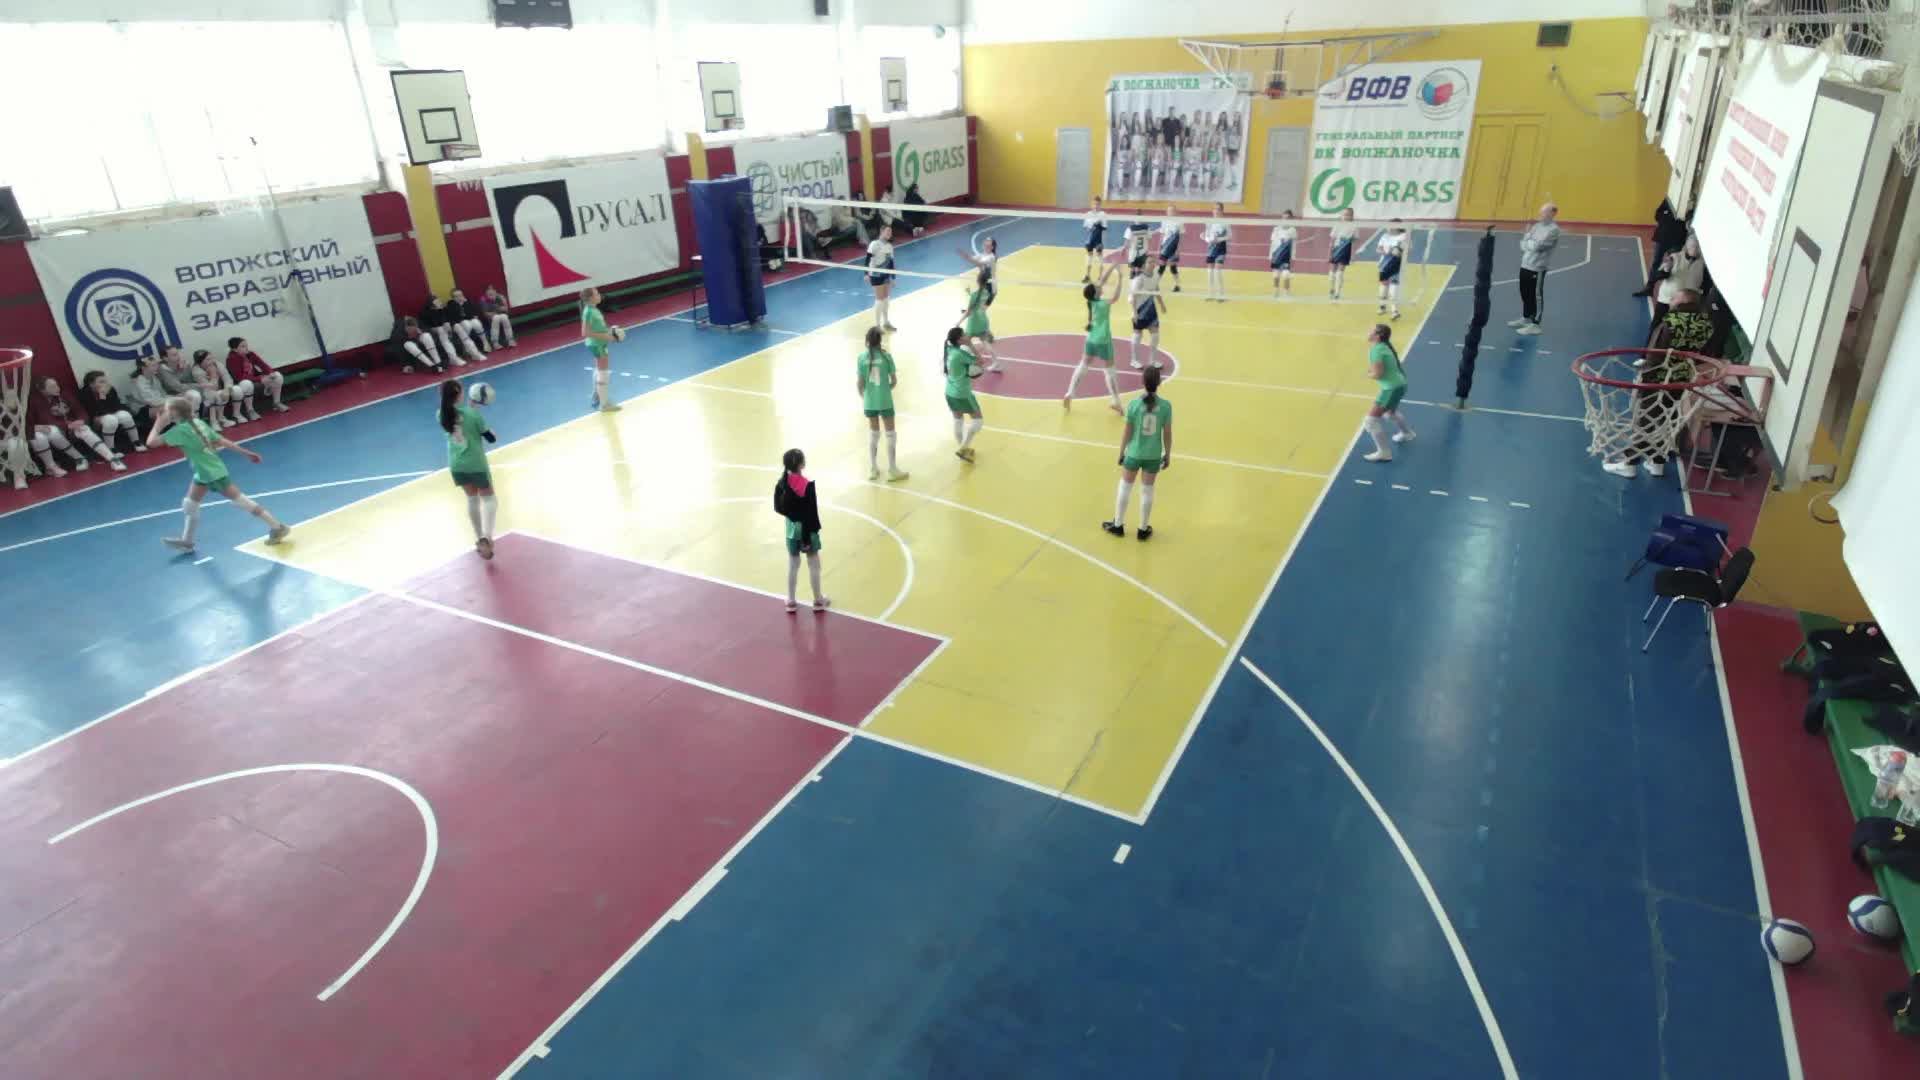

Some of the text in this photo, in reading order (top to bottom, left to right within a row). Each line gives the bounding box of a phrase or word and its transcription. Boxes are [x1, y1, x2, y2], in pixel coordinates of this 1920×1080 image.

[1346, 75, 1412, 101] ВФВ
[778, 151, 845, 182] ЧИСТЫЙ
[923, 145, 965, 174] GRASS
[1341, 147, 1461, 159] ВОЛЖАНОЧКА
[1362, 180, 1455, 203] GRASS
[576, 192, 667, 235] РУСАЛ
[175, 238, 340, 284] ВОЛЖСКИЙ
[185, 256, 372, 308] АБРАЗИВНЫЙ
